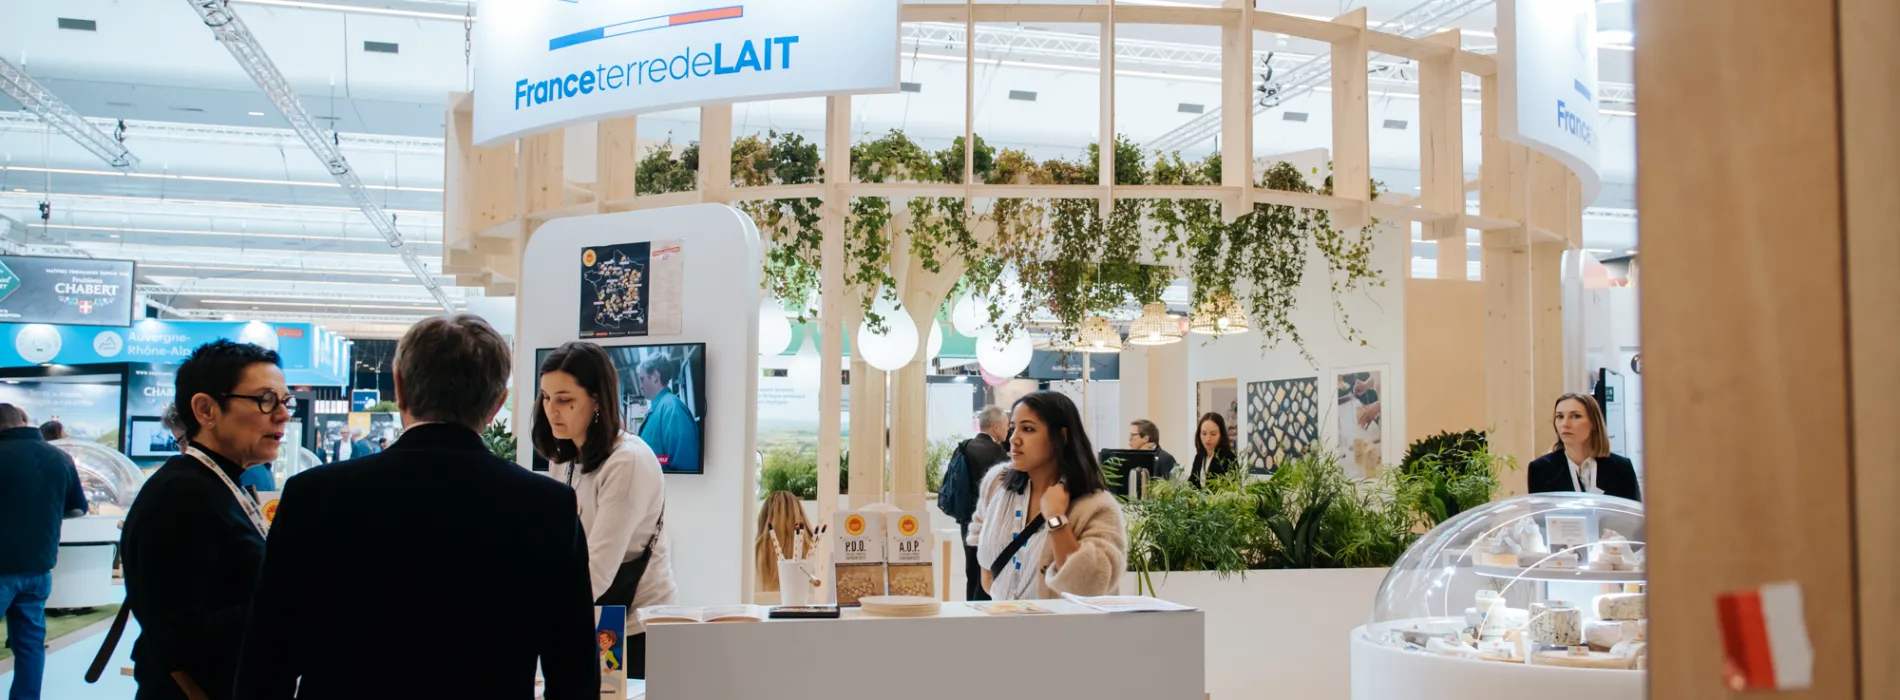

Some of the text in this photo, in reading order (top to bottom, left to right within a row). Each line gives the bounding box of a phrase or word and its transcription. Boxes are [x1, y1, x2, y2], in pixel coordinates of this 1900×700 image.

[515, 35, 799, 110] FranceterredeLAIT
[54, 283, 119, 296] CHABERT
[128, 331, 191, 344] Auvergne-
[127, 345, 193, 357] Rhône-Alp
[143, 386, 174, 397] CHAB
[845, 540, 867, 552] P.D.O.
[899, 540, 920, 552] A.O.P.
